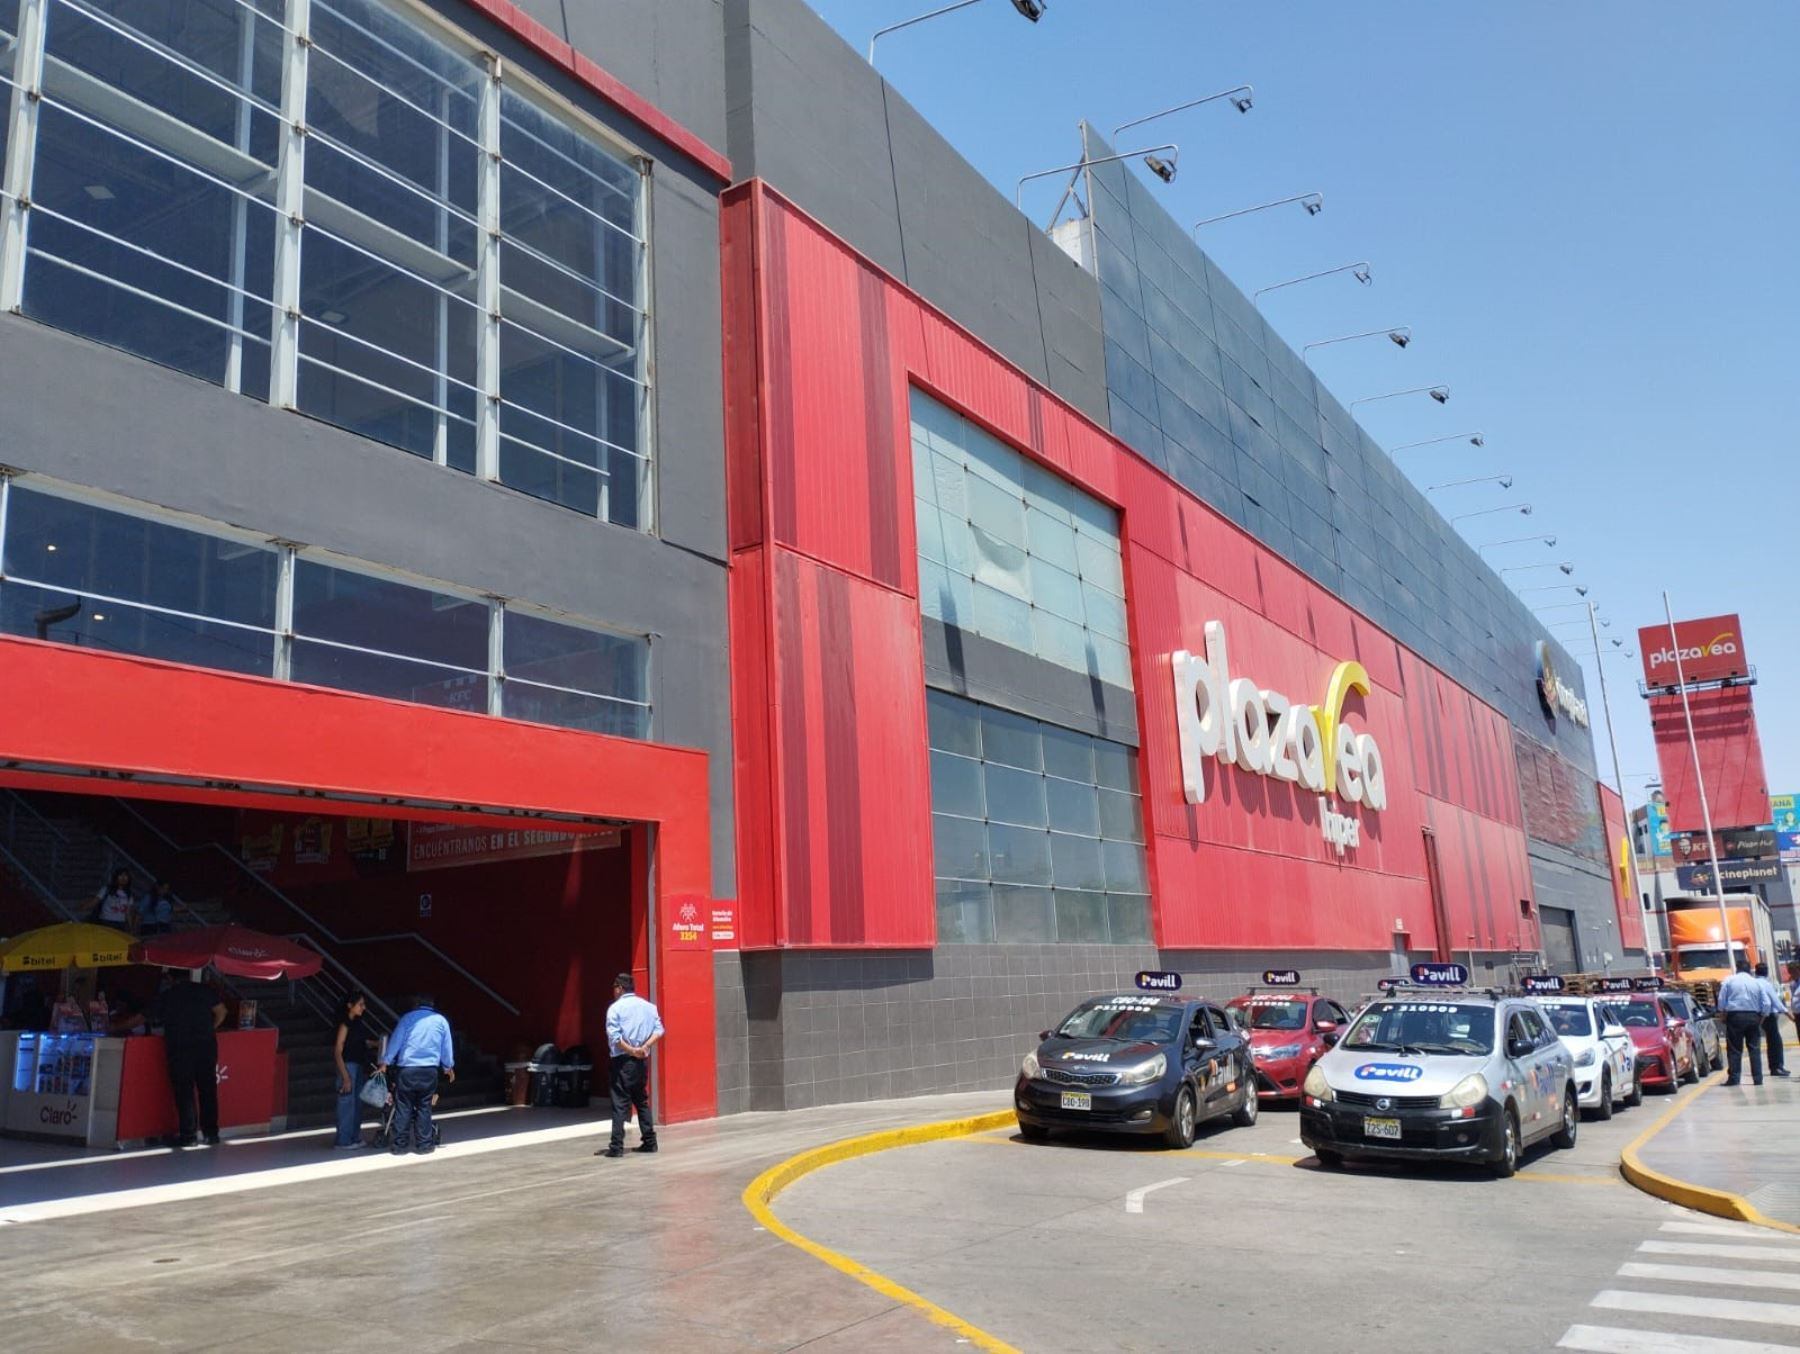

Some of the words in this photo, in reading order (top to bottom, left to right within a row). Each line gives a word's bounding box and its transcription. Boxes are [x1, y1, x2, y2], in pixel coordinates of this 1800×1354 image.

[1318, 796, 1360, 856] hiper
[490, 834, 504, 850] EN
[508, 832, 520, 847] EL
[1719, 866, 1778, 880] cineplanet
[1267, 971, 1296, 983] Pavill
[1417, 965, 1461, 982] Pavill
[1141, 974, 1177, 988] Pavill
[1526, 977, 1560, 990] Pavill
[1602, 978, 1631, 990] Pavill
[1636, 977, 1660, 988] Pavill
[1061, 1050, 1111, 1063] Pavill
[1360, 1066, 1420, 1080] Pavill
[40, 1105, 72, 1125] Claro
